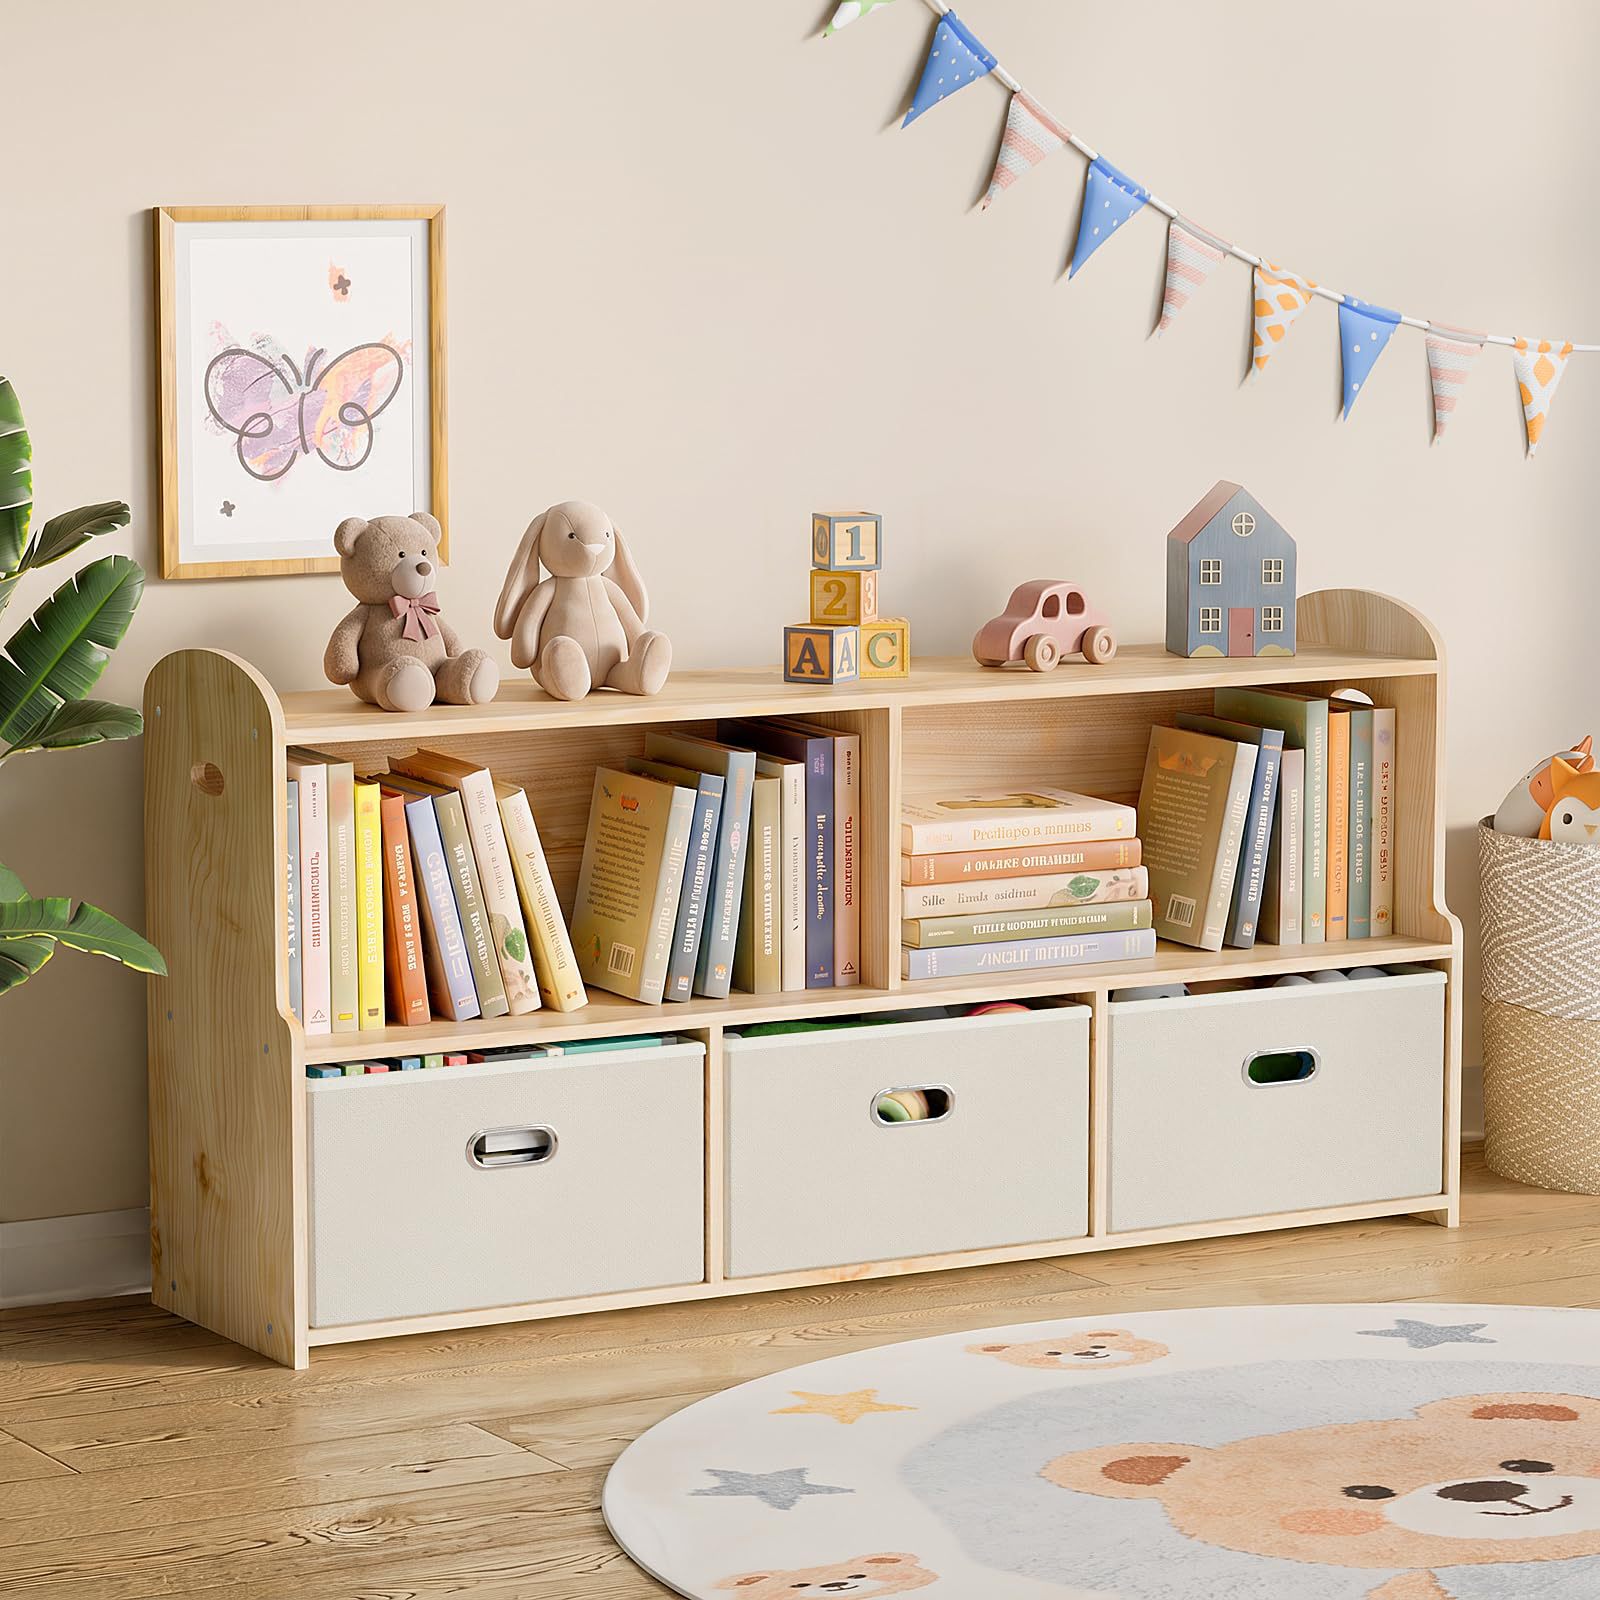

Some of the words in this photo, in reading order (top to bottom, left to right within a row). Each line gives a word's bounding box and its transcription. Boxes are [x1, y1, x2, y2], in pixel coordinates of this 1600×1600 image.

[846, 525, 866, 561] 1
[823, 579, 848, 616] 2
[864, 577, 874, 615] 3
[792, 637, 825, 676] A
[837, 636, 855, 674] A
[868, 632, 898, 668] C
